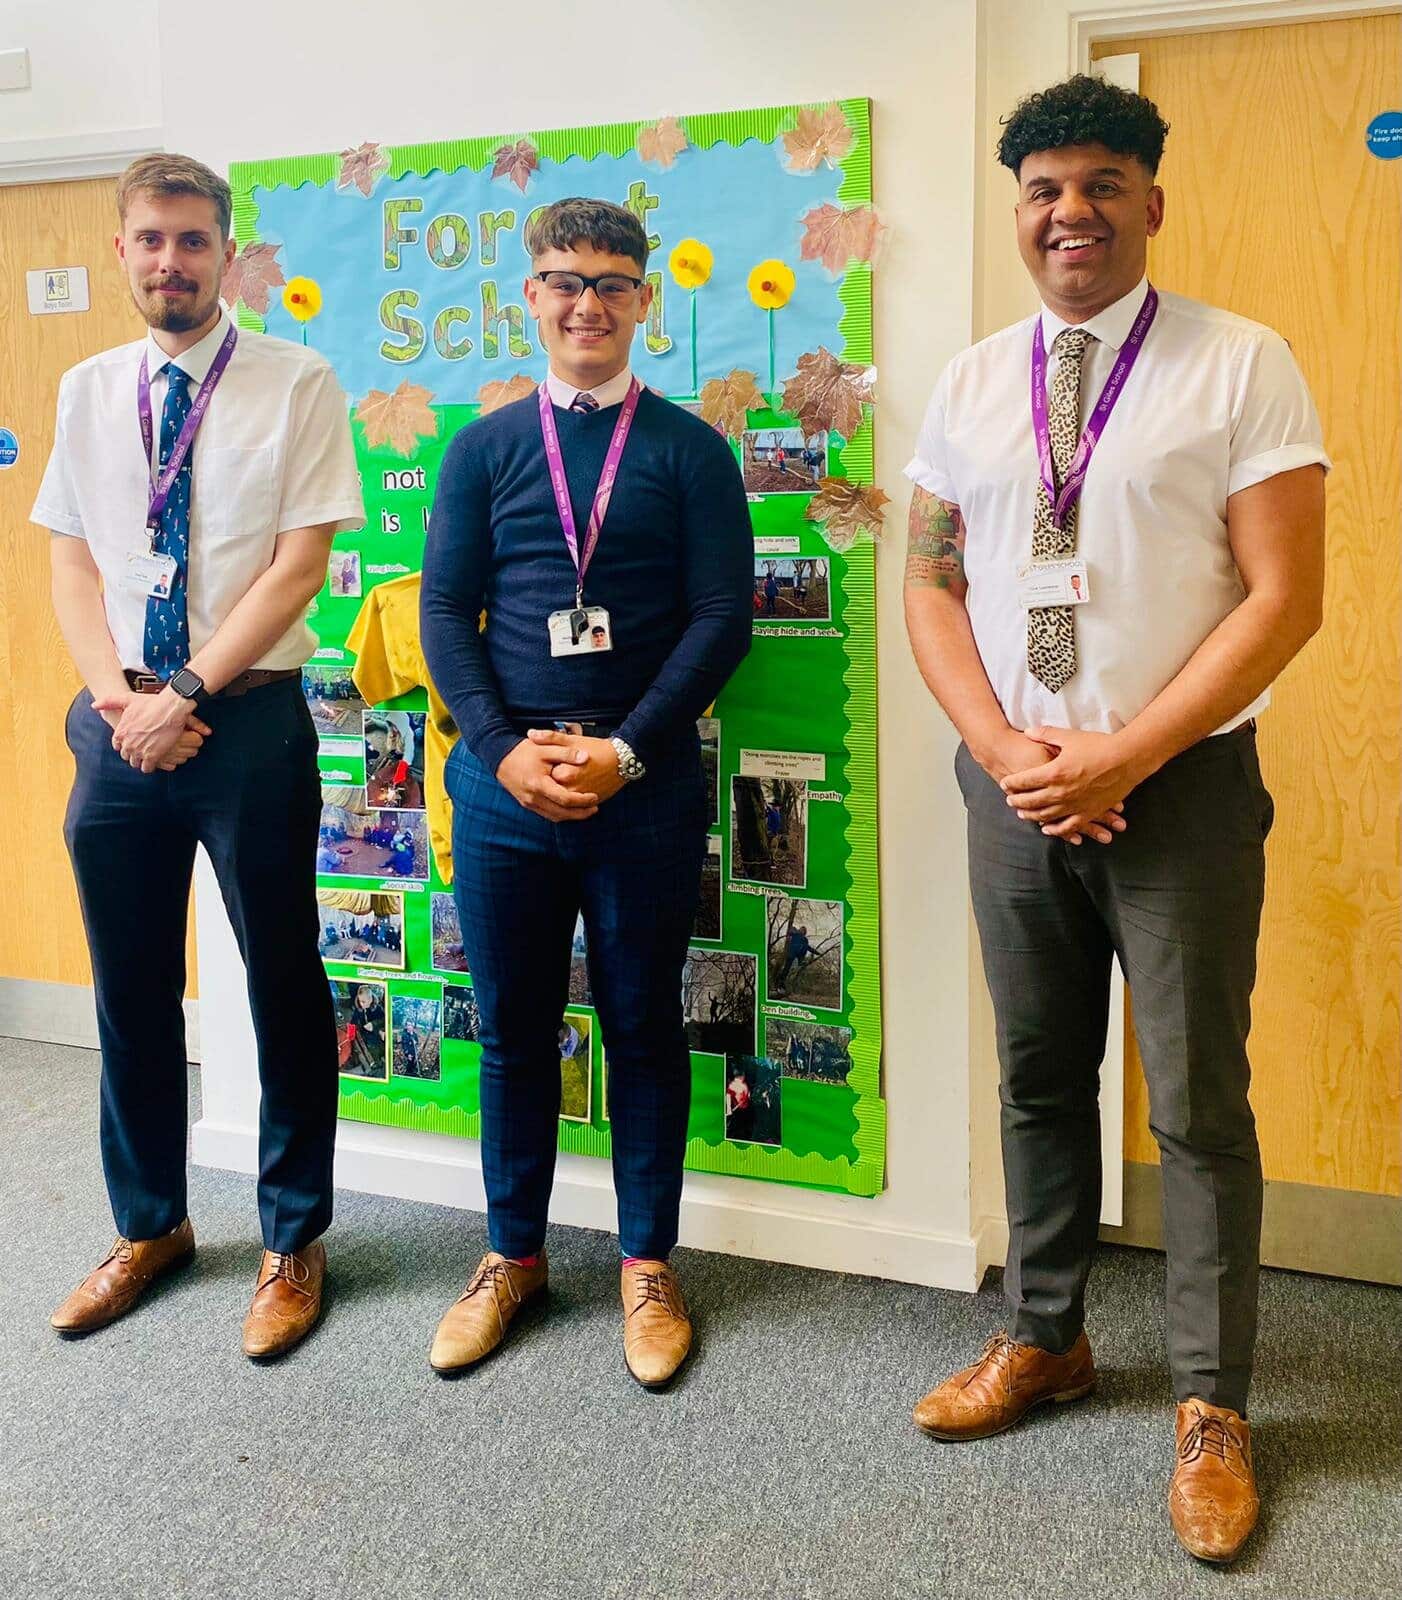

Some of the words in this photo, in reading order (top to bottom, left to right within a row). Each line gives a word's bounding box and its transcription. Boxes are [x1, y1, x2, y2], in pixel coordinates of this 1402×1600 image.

[383, 180, 663, 271] Fort
[379, 271, 673, 362] Schl
[1104, 385, 1115, 403] Giles
[1112, 362, 1126, 385] School
[383, 466, 425, 490] not
[382, 507, 400, 533] is
[781, 627, 798, 636] hide
[800, 627, 816, 636] and
[807, 791, 842, 802] Empathy
[727, 883, 760, 895] Climbing
[761, 1005, 777, 1014] Den
